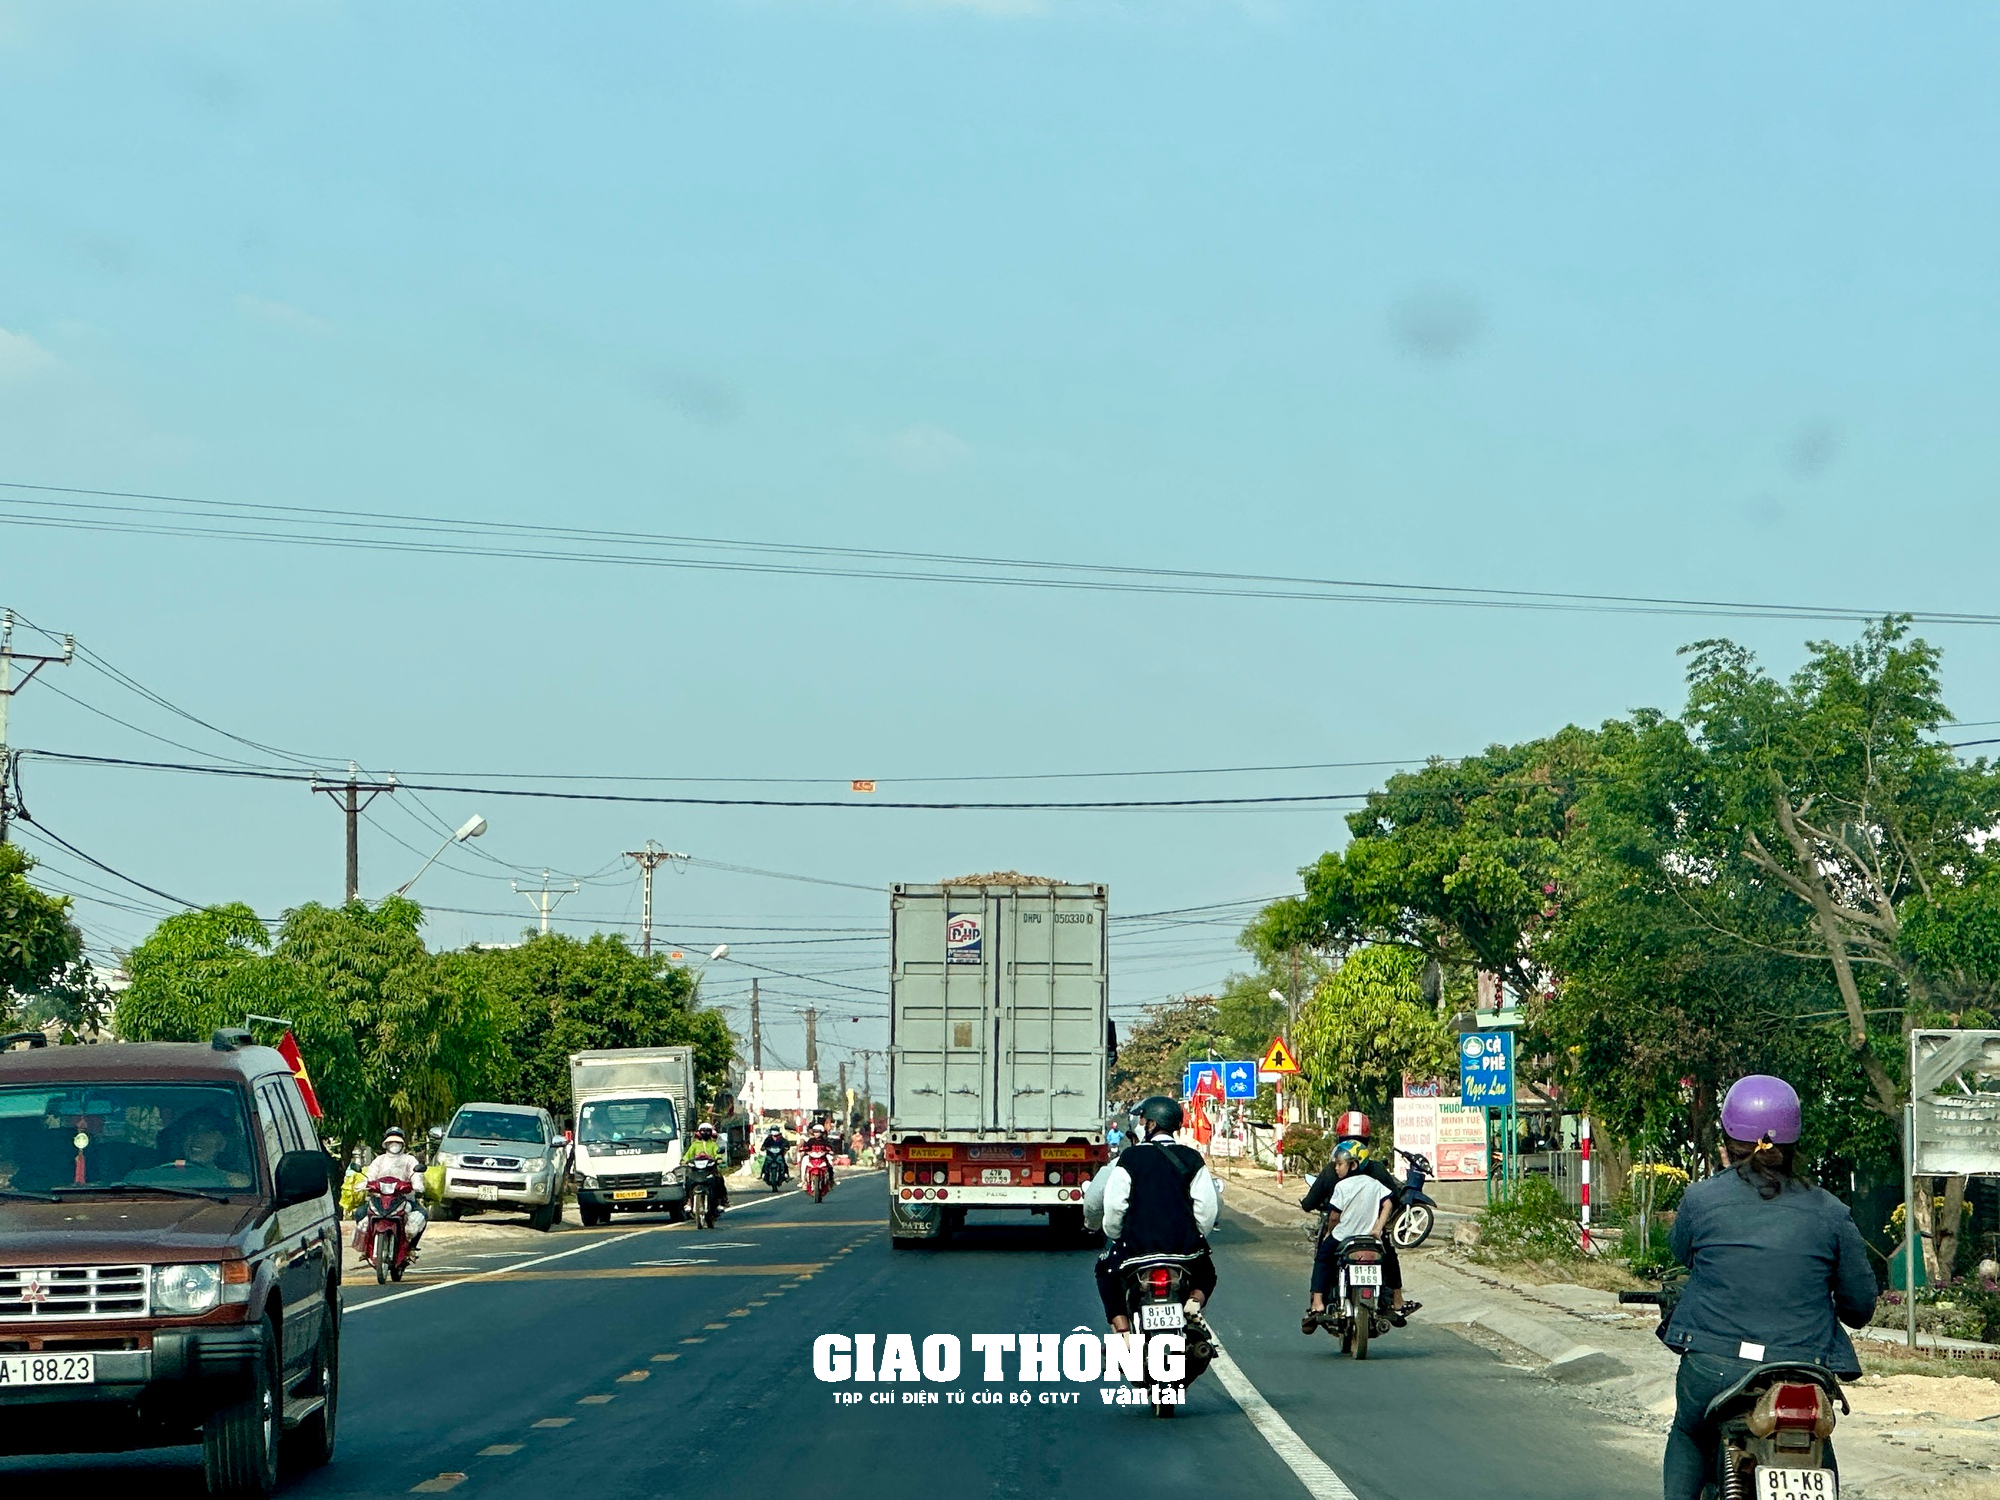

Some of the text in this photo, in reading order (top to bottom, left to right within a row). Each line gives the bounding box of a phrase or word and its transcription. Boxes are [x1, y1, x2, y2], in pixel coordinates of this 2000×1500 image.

[1023, 913, 1042, 924] DHPU
[1486, 1035, 1502, 1054] CÀ
[1482, 1053, 1506, 1072] PHÊ
[1441, 1116, 1464, 1125] MINH
[615, 1148, 642, 1156] ISUZU
[911, 1149, 939, 1157] PATEC
[1043, 1149, 1072, 1157] PATEC
[901, 1221, 932, 1230] PATEC
[1768, 1470, 1824, 1491] 81-K8
